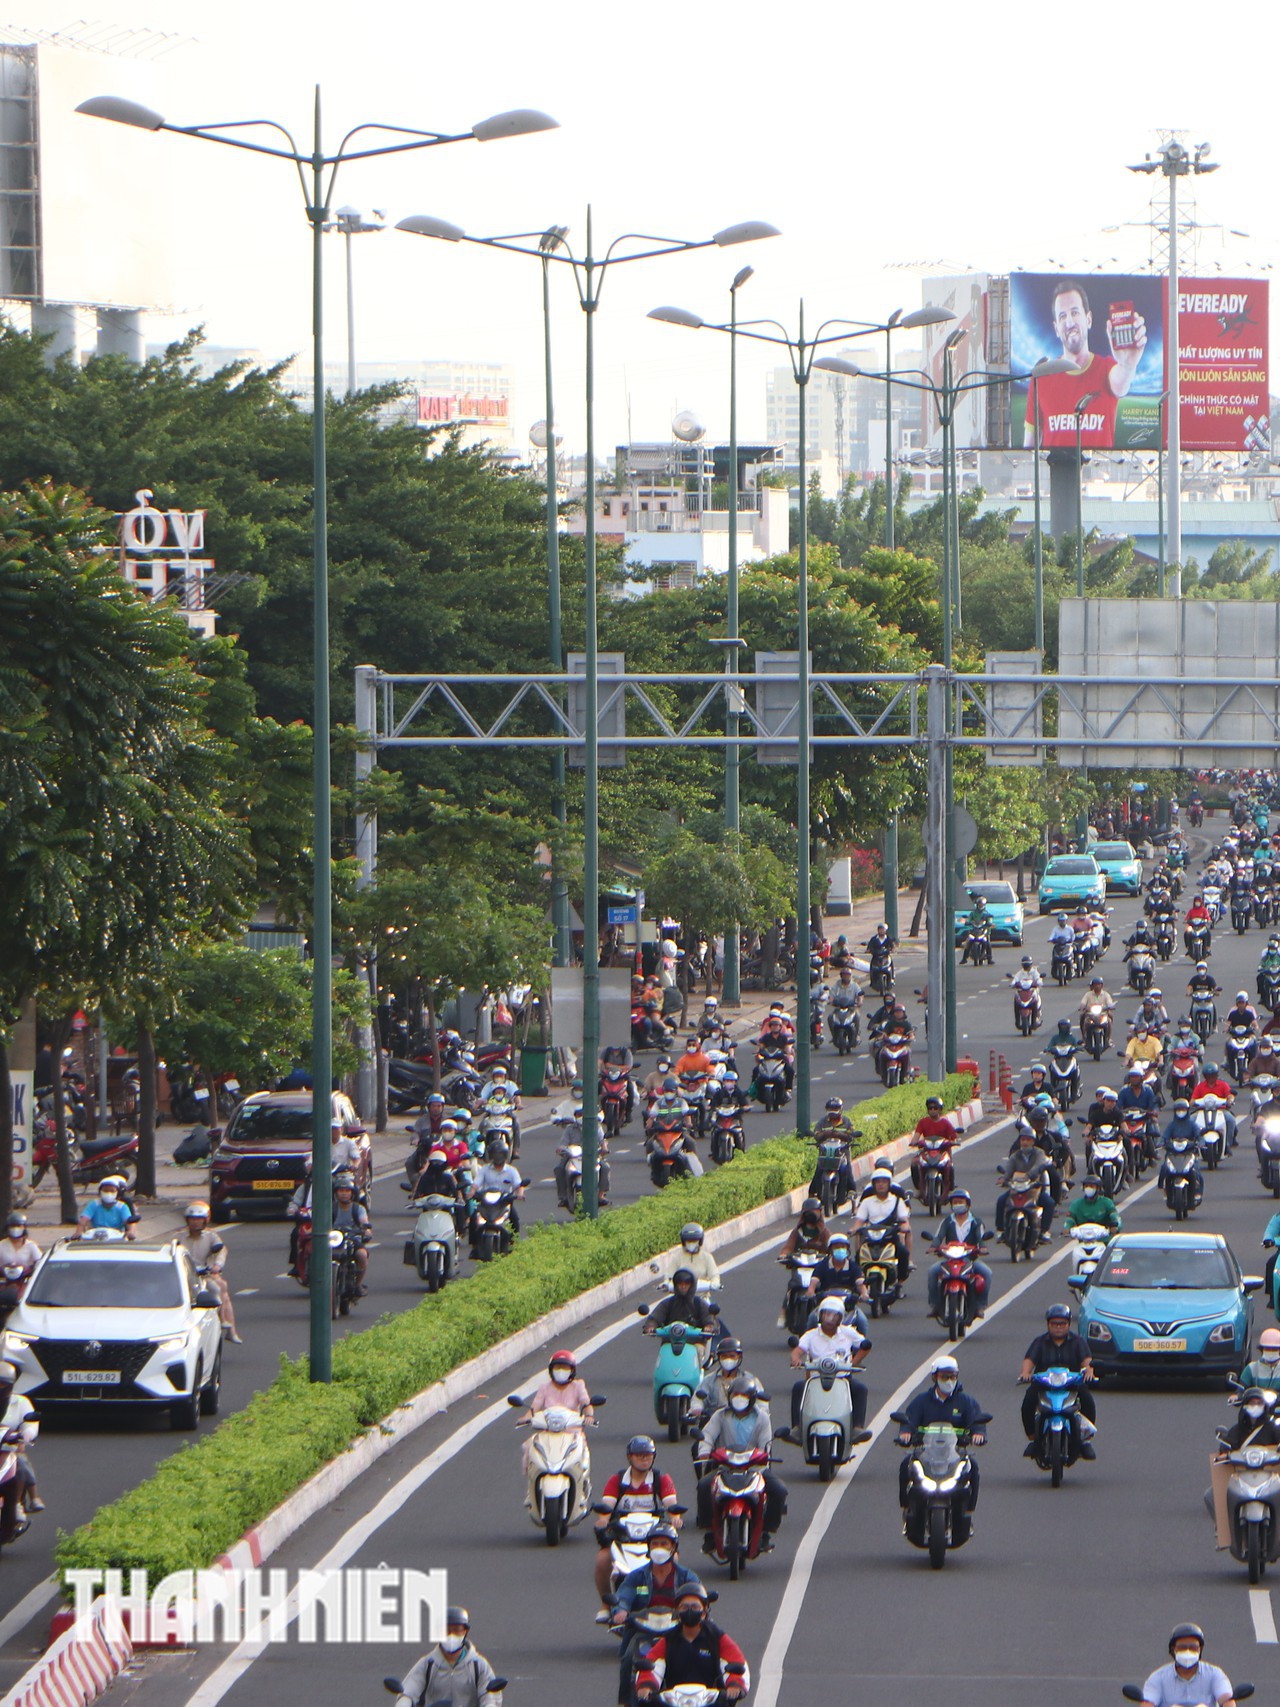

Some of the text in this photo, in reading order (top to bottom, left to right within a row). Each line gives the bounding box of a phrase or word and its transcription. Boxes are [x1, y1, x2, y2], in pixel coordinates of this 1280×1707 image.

[1178, 293, 1248, 314] EVEREADY
[1179, 344, 1262, 362] HẤT LƯỢNG UY TÍN
[1179, 369, 1196, 382] UÔN
[1197, 369, 1222, 382] LUÔN
[1242, 369, 1266, 382] SÀNG
[1230, 394, 1242, 404] CÓ
[1226, 405, 1244, 415] NAM
